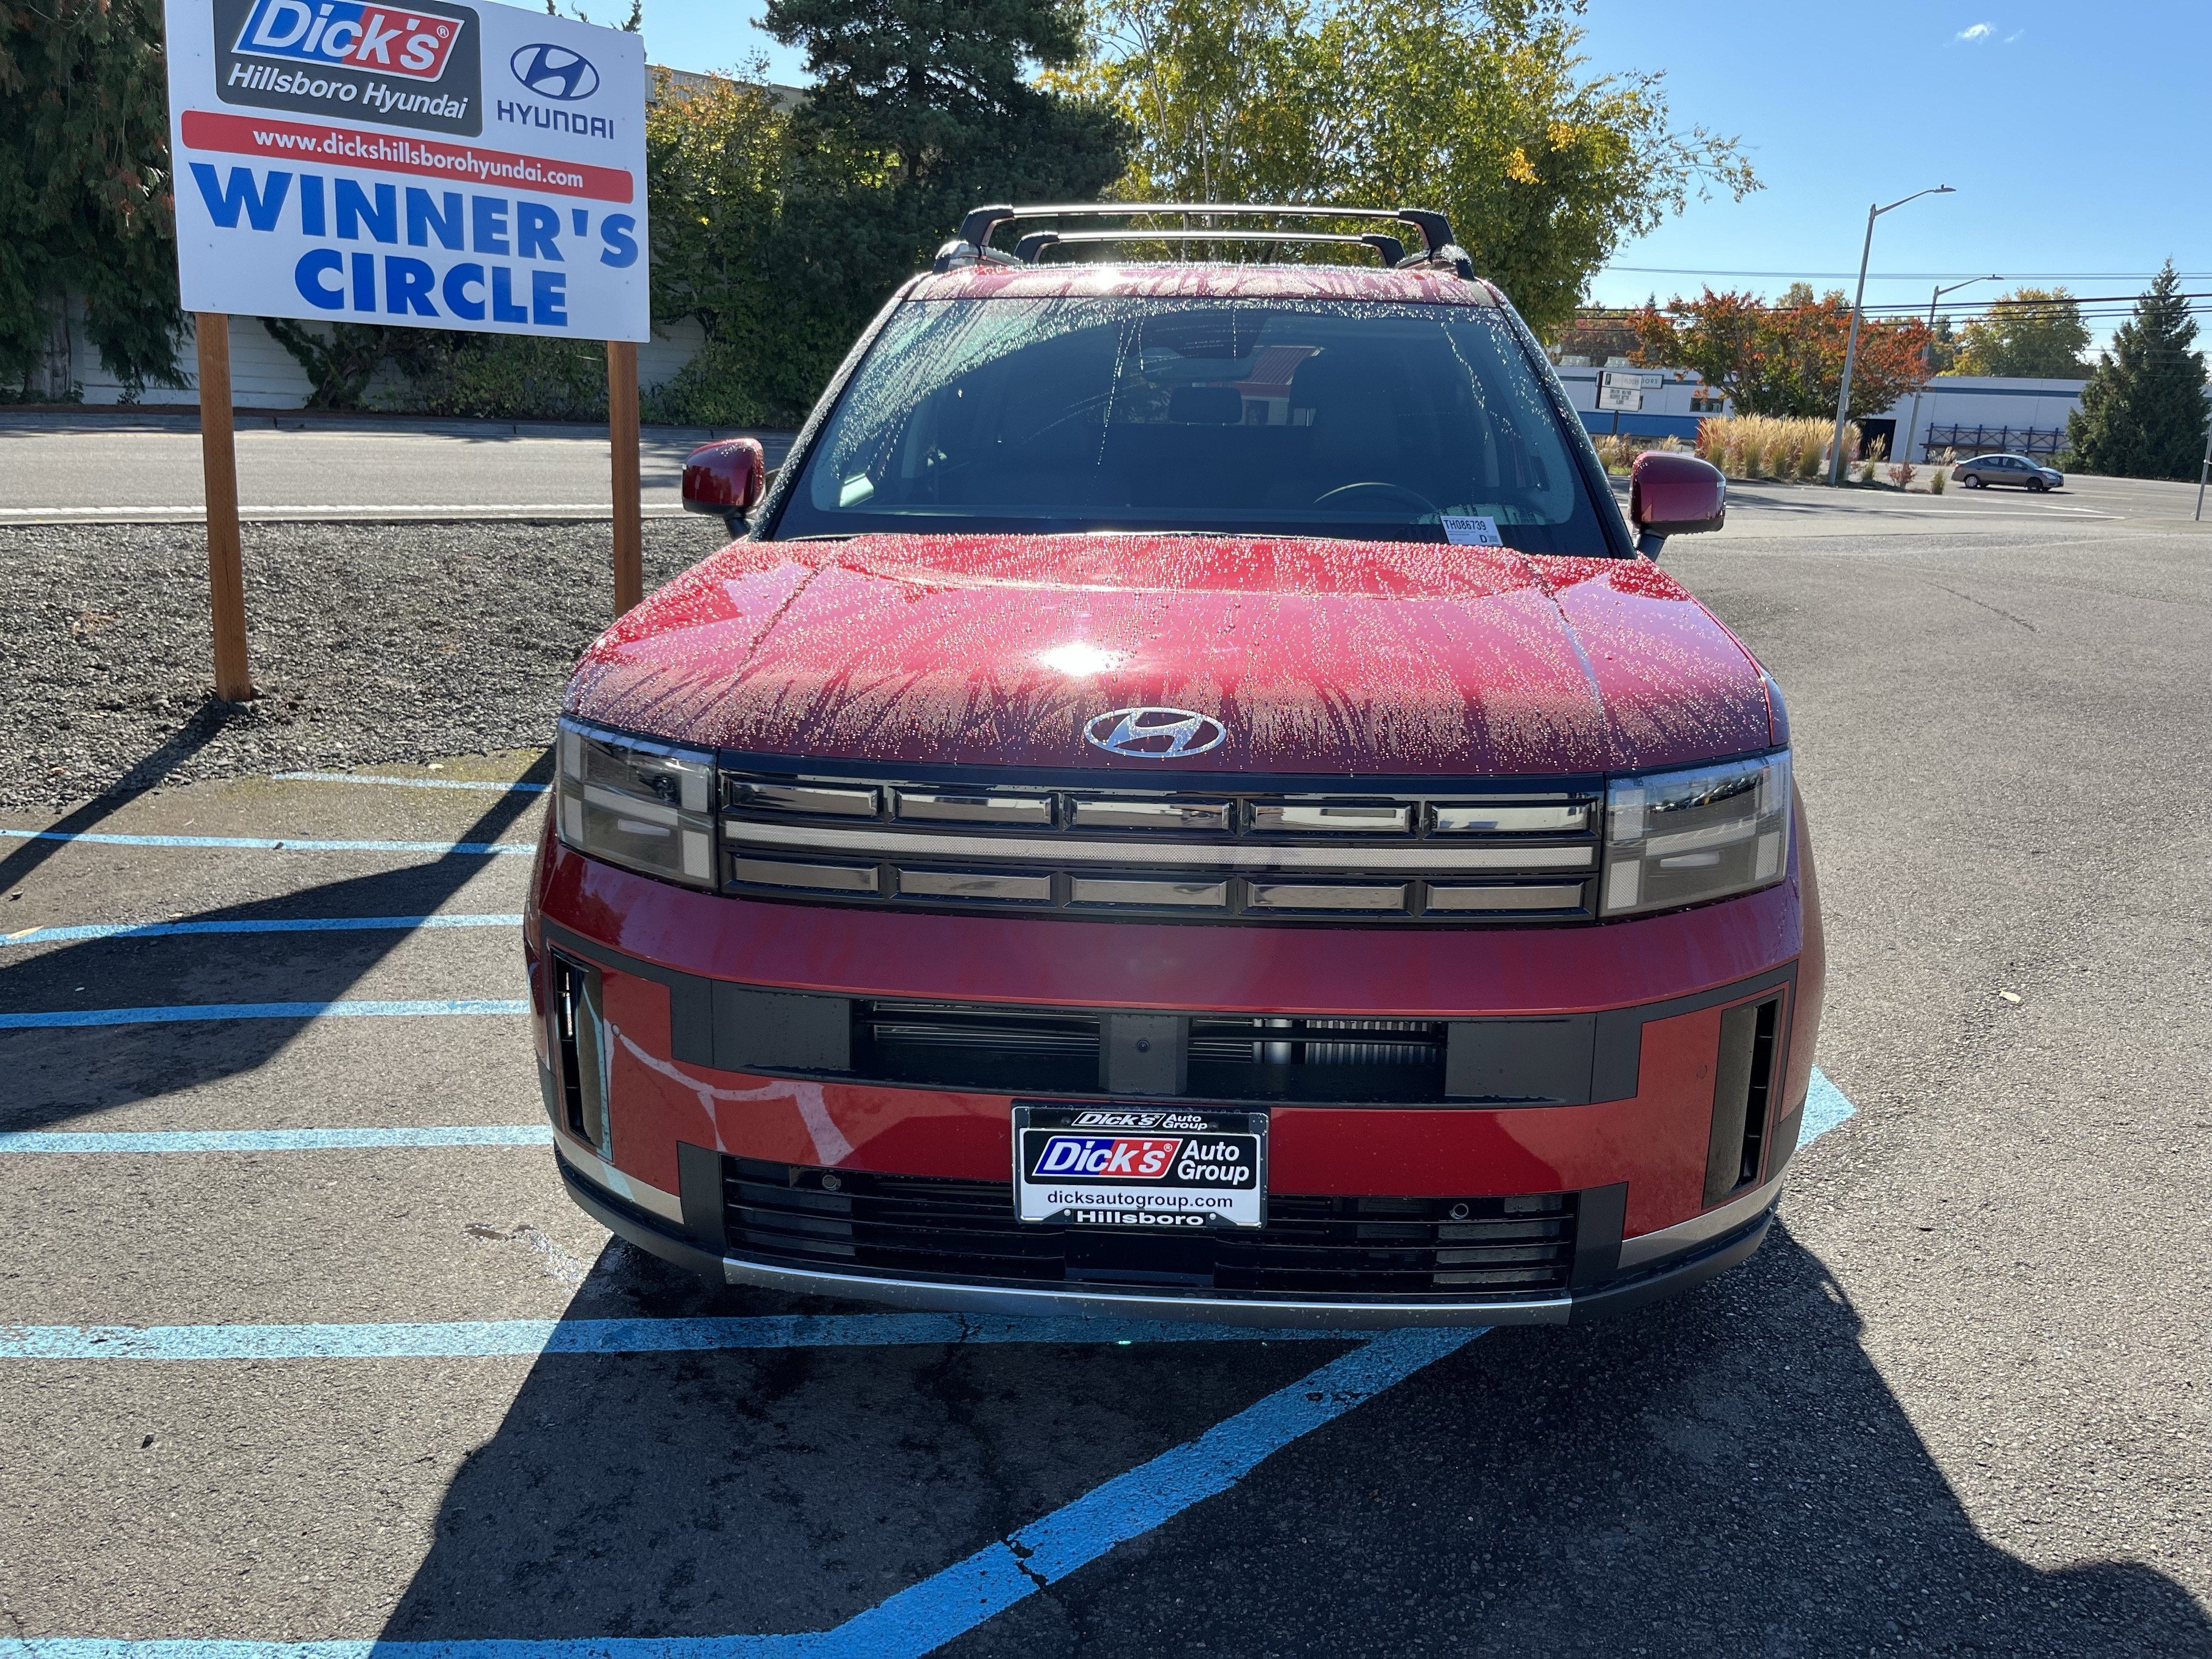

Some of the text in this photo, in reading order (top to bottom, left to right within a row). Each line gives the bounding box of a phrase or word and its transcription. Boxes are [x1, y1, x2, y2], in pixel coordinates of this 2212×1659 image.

[252, 0, 439, 70] Dick's
[228, 63, 469, 120] Hillsboro Hyundai
[498, 100, 614, 140] HYUNDAI
[253, 128, 583, 188] www.dickshillsborohyundai.com
[189, 162, 638, 268] WINNER'S
[295, 248, 568, 327] CIRCLE
[1443, 520, 1486, 531] TH086739
[1480, 534, 1487, 543] D
[1078, 1113, 1201, 1125] Dick's Auto
[1162, 1120, 1208, 1131] Group
[1043, 1139, 1239, 1173] Dick's Auto
[1177, 1160, 1250, 1185] Group
[1047, 1190, 1233, 1212] dicksautogroup.com
[1076, 1210, 1204, 1225] Hillsboro
